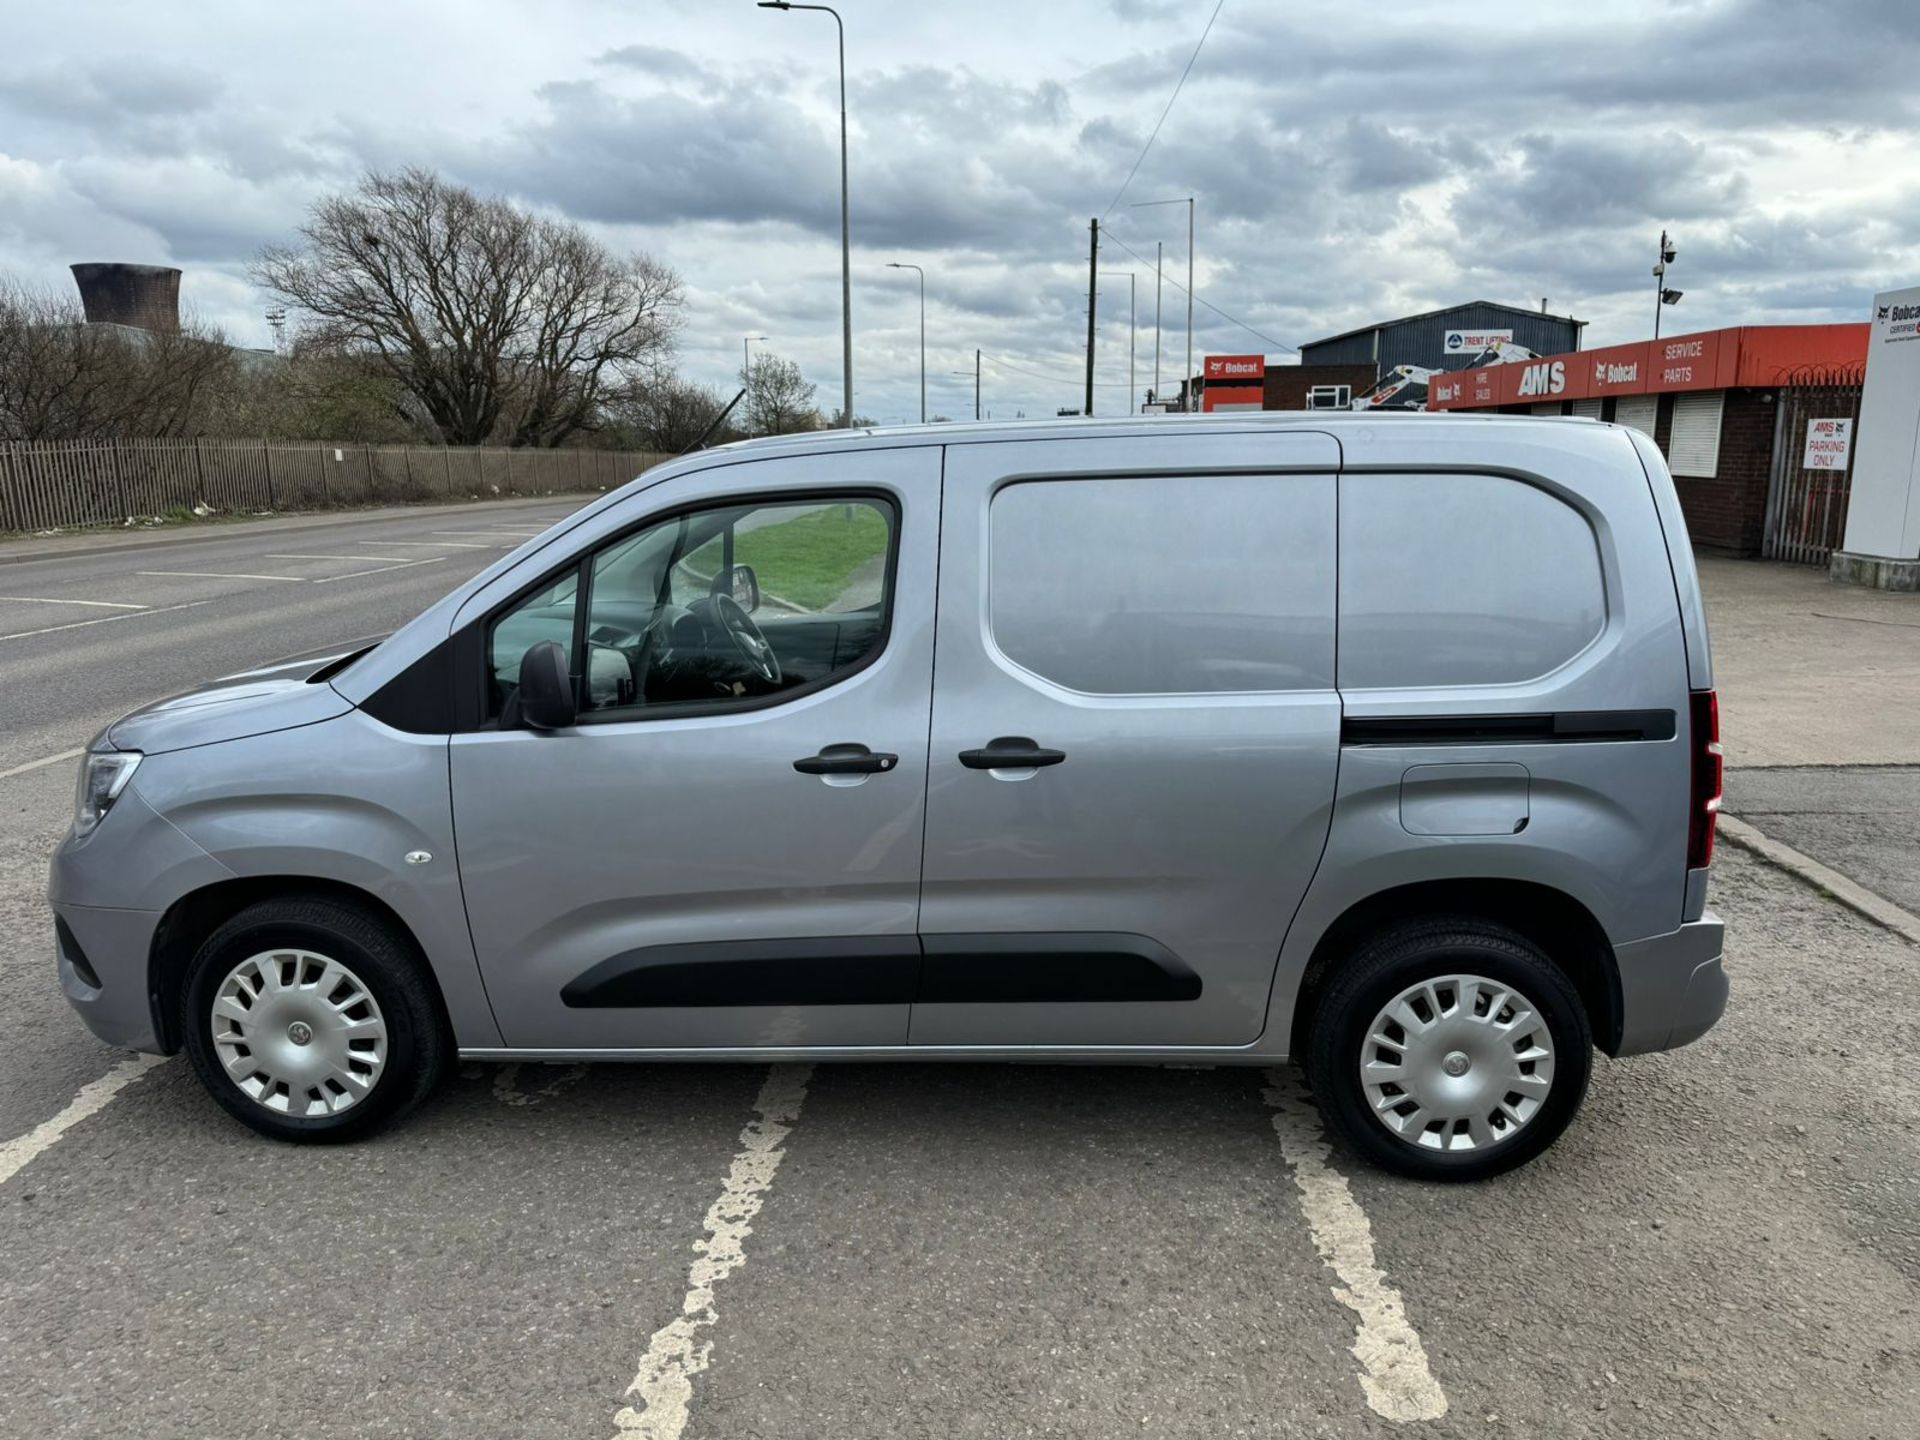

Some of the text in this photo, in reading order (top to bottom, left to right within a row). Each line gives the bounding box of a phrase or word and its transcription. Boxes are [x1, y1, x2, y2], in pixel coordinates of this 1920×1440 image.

[1891, 304, 1920, 321] Bobca
[1464, 335, 1484, 346] TRENT
[1665, 341, 1703, 359] SERVICE
[1225, 362, 1257, 373] Bobcat
[1607, 362, 1637, 383] Bobcat
[1517, 361, 1566, 396] AMS
[1664, 367, 1692, 383] PARTS
[1813, 422, 1835, 433] AMS
[1809, 440, 1845, 452] PARKING
[1813, 454, 1835, 466] ONLY
